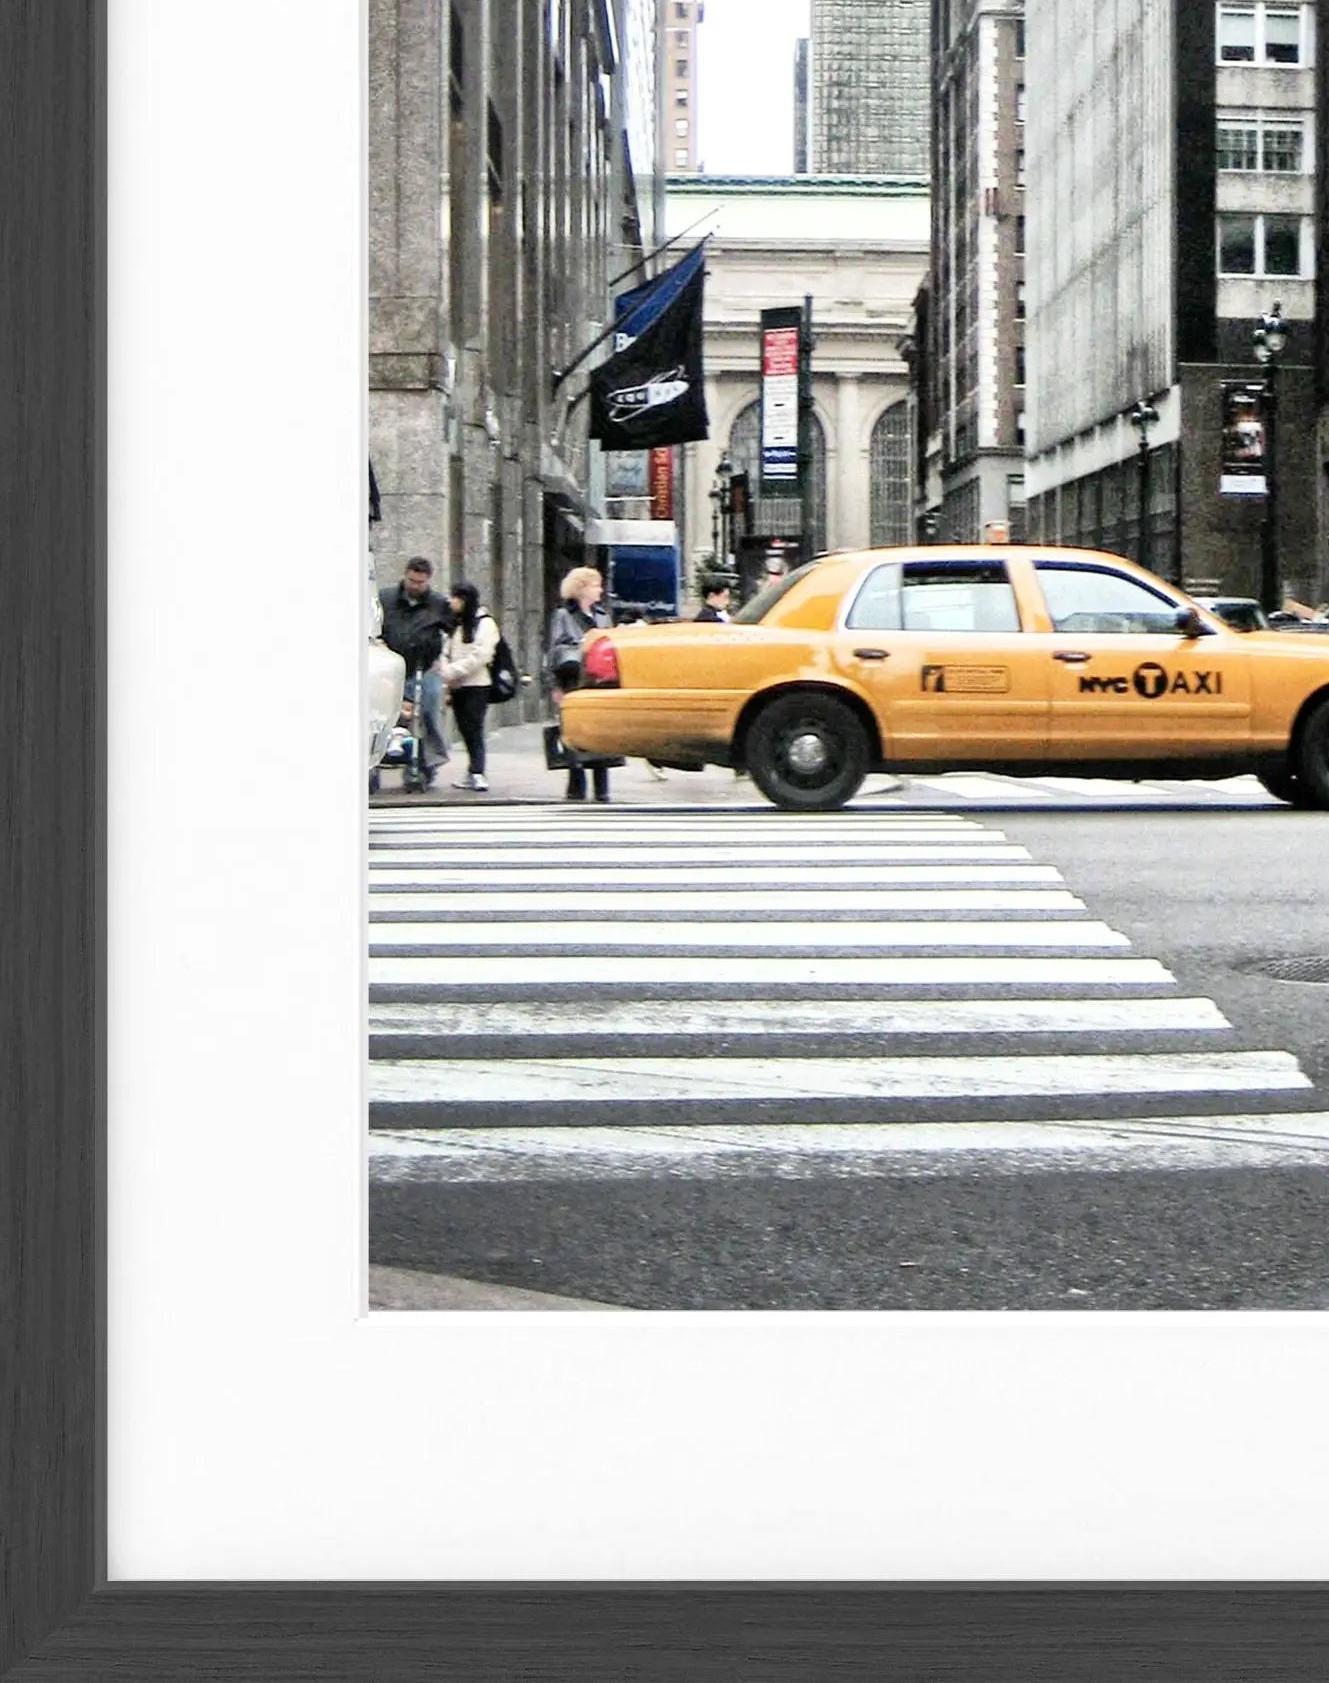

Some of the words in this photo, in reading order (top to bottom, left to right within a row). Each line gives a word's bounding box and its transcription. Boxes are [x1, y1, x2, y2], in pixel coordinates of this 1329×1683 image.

[653, 466, 669, 518] Christian
[1079, 675, 1129, 694] NYC
[1133, 662, 1223, 699] TAXI
